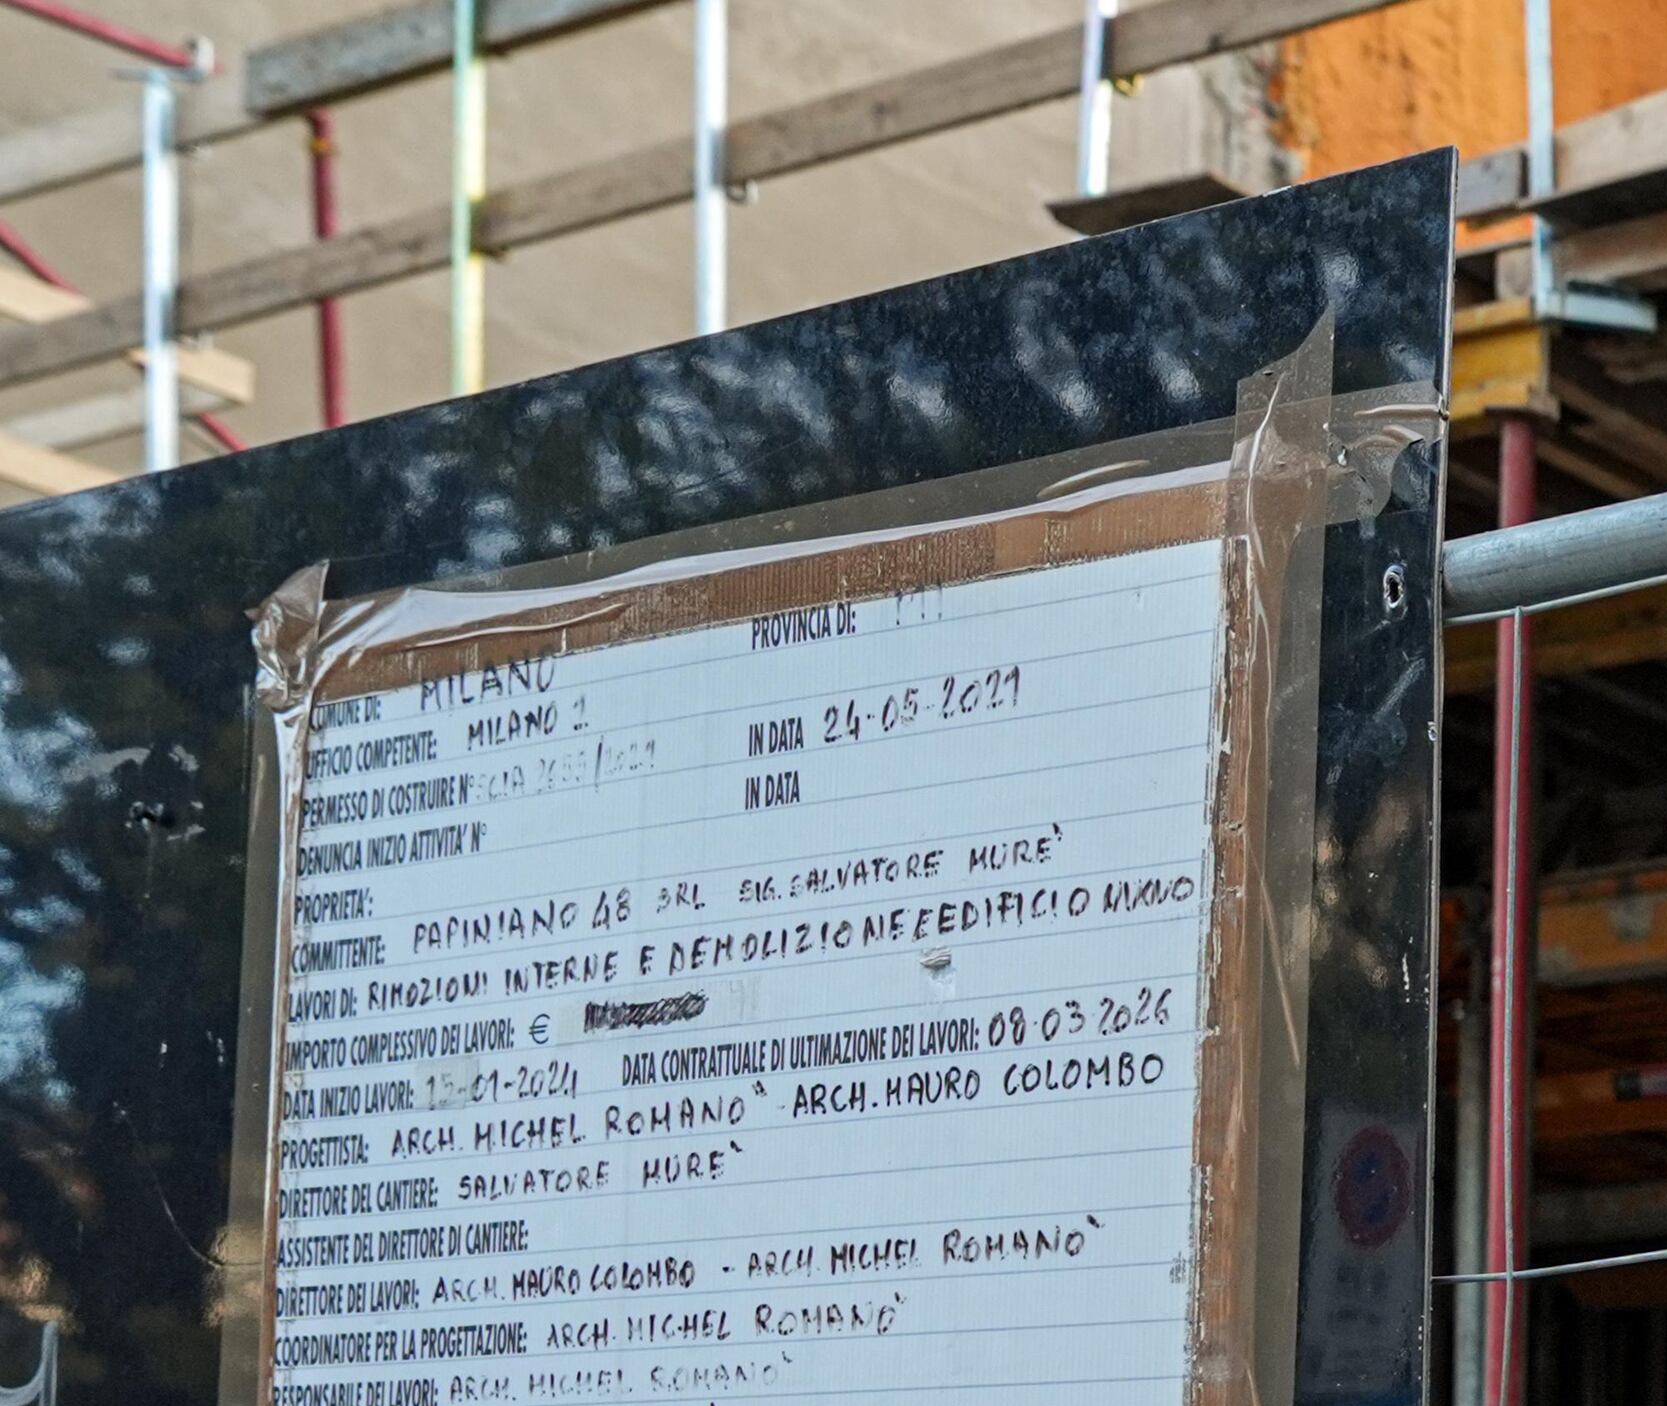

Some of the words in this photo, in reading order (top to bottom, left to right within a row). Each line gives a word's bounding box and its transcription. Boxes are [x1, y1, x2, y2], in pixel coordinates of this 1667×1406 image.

[752, 604, 832, 650] PROVINCIA
[837, 603, 856, 637] DI:
[420, 658, 555, 711] MILANO
[467, 700, 558, 751] MILANO
[749, 724, 764, 757] IN
[768, 717, 804, 753] DATA
[353, 730, 437, 772] COMPETENTE:
[302, 790, 367, 828] PERMESSO
[371, 788, 384, 819] DI
[388, 776, 457, 815] COSTRUIRE
[745, 776, 761, 810] IN
[765, 771, 801, 805] DATA
[299, 838, 362, 876] DENUNCIA
[367, 833, 406, 866] INIZIO
[414, 899, 576, 954] PAPINIANO
[592, 887, 631, 931] 48
[291, 934, 386, 975] COMMITTENTE:
[505, 950, 619, 997] INTERNE
[639, 945, 656, 975] E
[288, 990, 336, 1023] LAVORI
[339, 988, 357, 1017] DI:
[350, 1021, 437, 1065] COMPLESSIVO
[440, 1022, 461, 1055] DEI
[464, 1018, 514, 1051] LAVORI:
[529, 1013, 551, 1045] €
[622, 1051, 658, 1087] DATA
[661, 1039, 766, 1081] CONTRATTUALE
[771, 1037, 786, 1071] DI
[789, 1027, 887, 1068] ULTIMAZIONE
[891, 1023, 914, 1056] DEI
[920, 1017, 979, 1055] LAVORI:
[1004, 1053, 1164, 1096] COLOMBO
[283, 1090, 316, 1120] DATA
[320, 1083, 358, 1114] INIZIO
[361, 1079, 414, 1111] LAVORI:
[280, 1135, 370, 1169] PROGETTISTA:
[279, 1181, 347, 1218] DIRETTORE
[350, 1184, 374, 1214] DEL
[377, 1178, 438, 1212] CANTIERE:
[458, 1160, 609, 1201] SALVATORE
[353, 1229, 375, 1263] DEL
[378, 1225, 445, 1260] DIRETTORE
[449, 1224, 461, 1257] DI
[465, 1220, 529, 1254] CANTIERE:
[347, 1284, 367, 1314] DEI
[370, 1279, 420, 1313] LAVORI:
[512, 1265, 582, 1301] MAURO
[590, 1255, 695, 1292] COLOMBO
[374, 1328, 399, 1359] PER
[402, 1328, 417, 1358] LA
[421, 1321, 528, 1357] PROGETTAZIONE:
